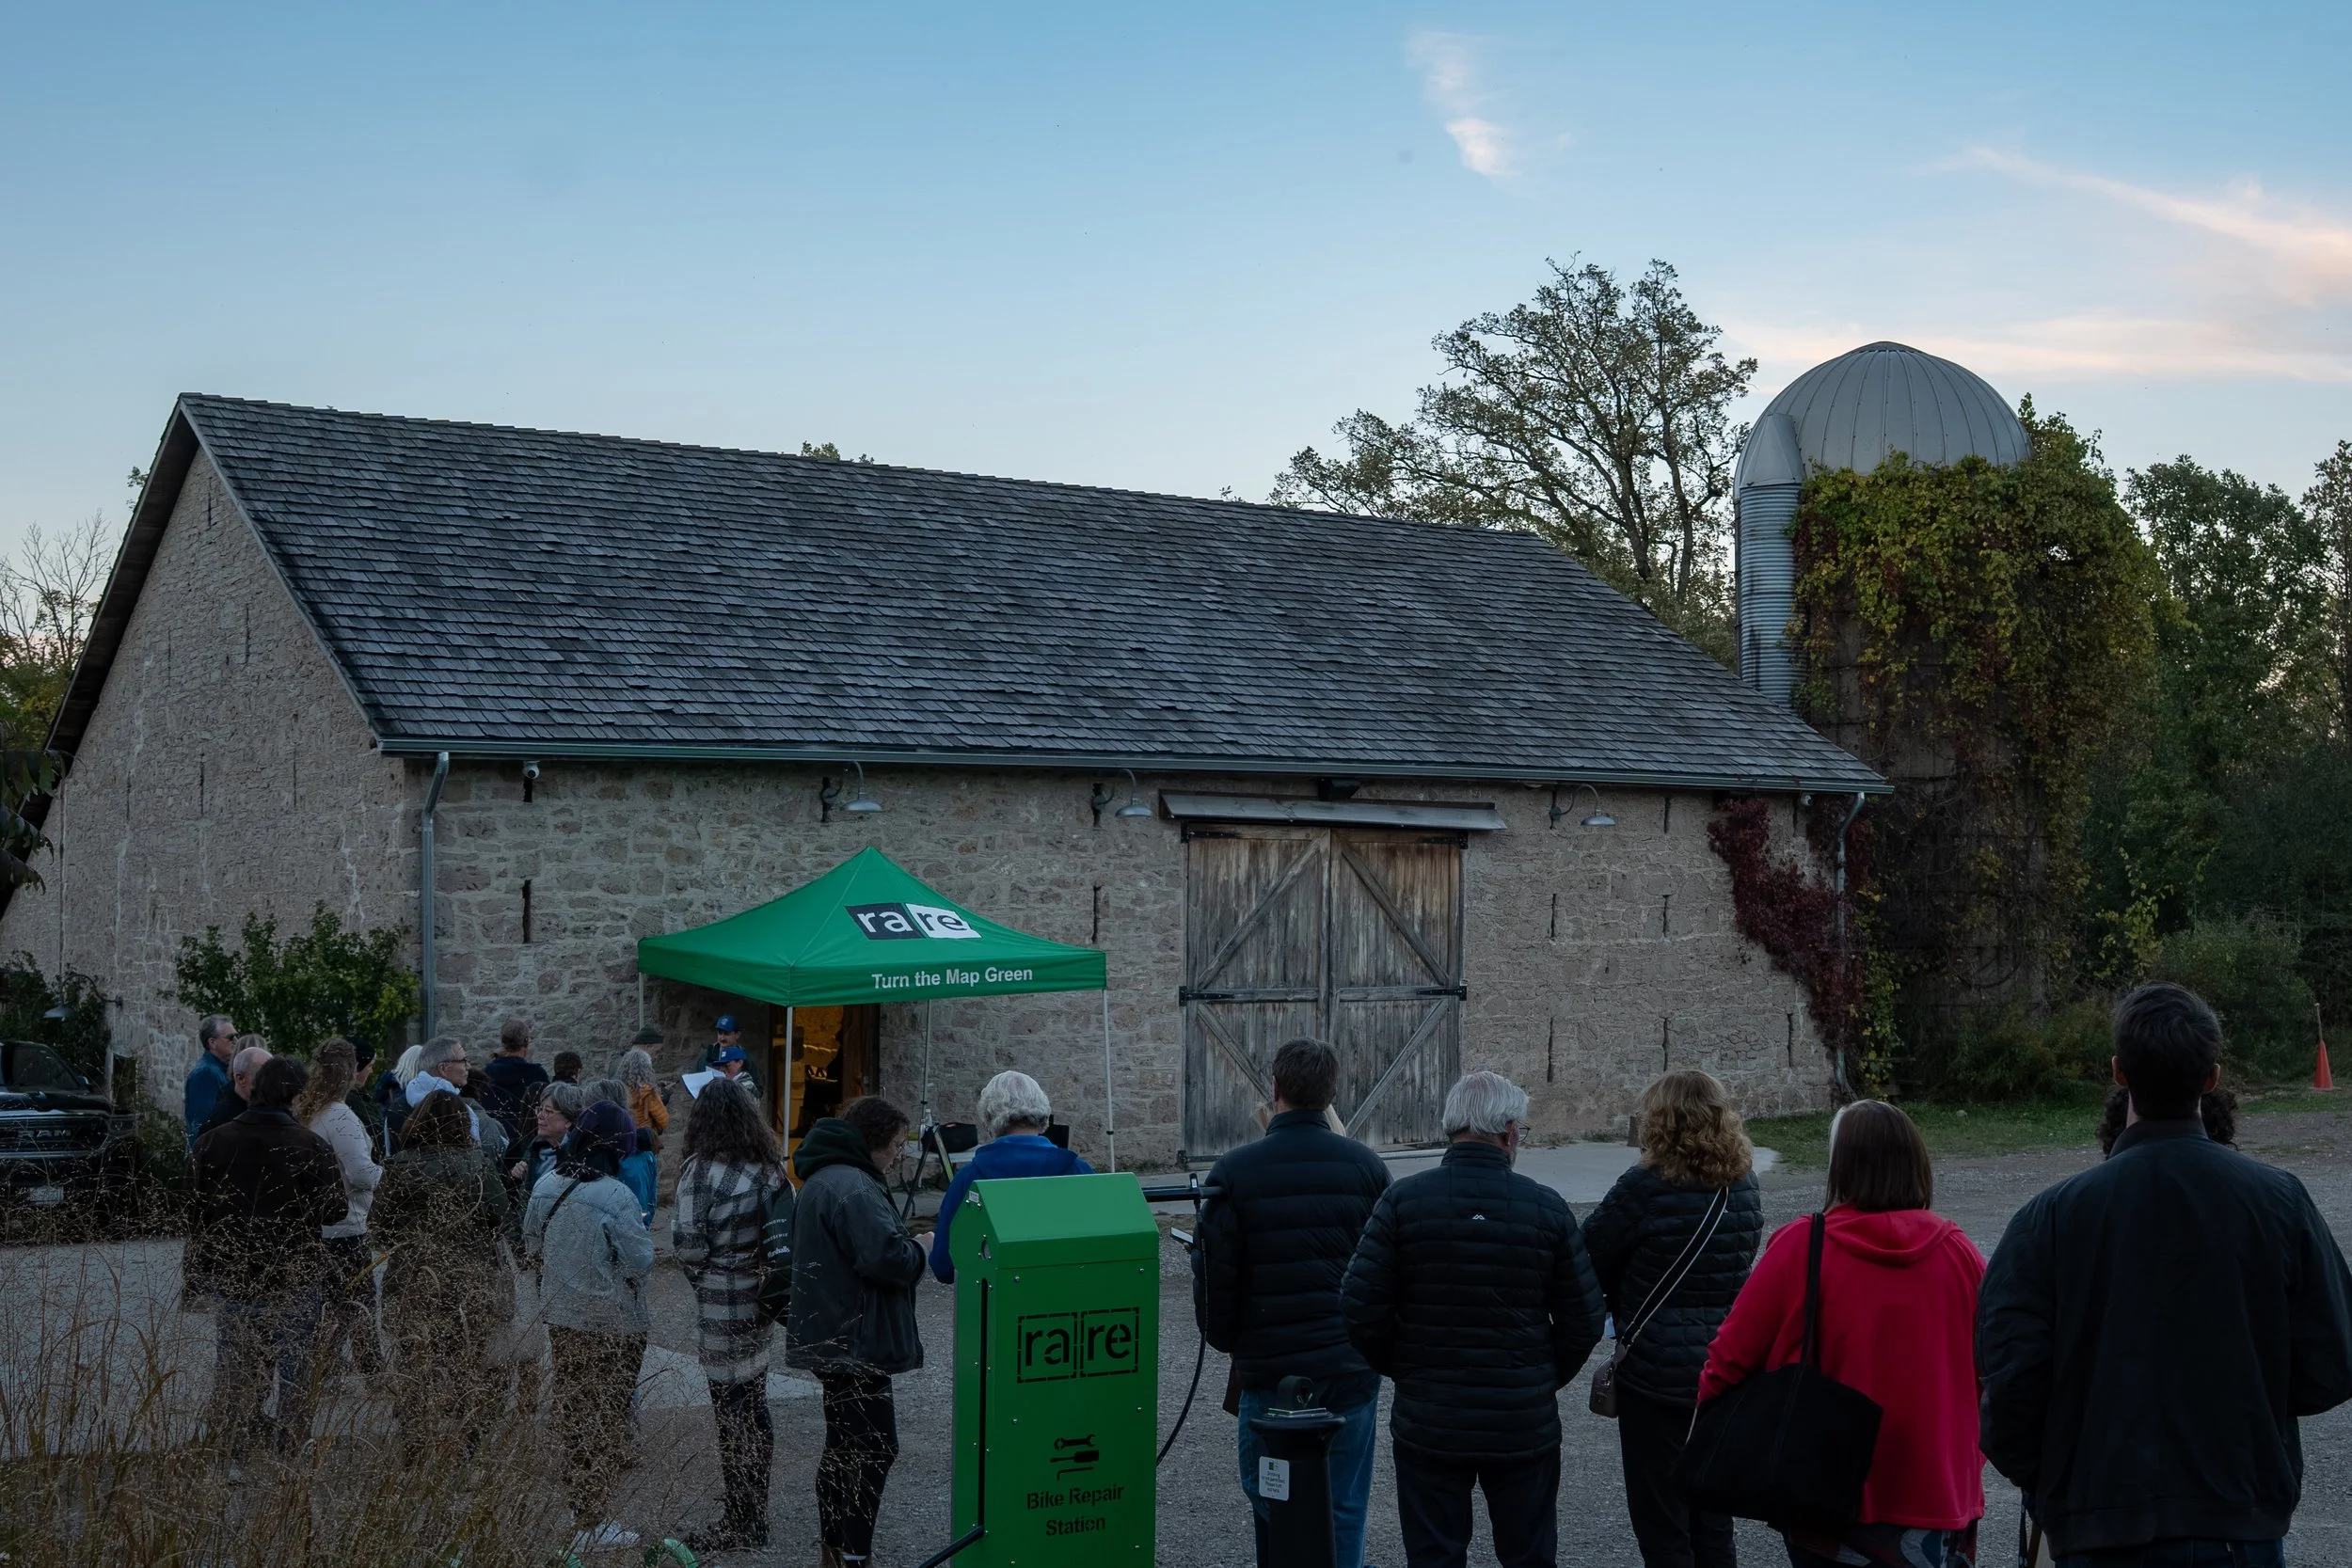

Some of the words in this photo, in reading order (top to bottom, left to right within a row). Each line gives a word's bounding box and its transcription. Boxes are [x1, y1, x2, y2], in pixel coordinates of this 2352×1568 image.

[857, 911, 967, 932] rare
[871, 974, 910, 989] Turn
[914, 971, 941, 987] the
[946, 969, 979, 987] Map
[985, 967, 1033, 982] Green
[1025, 1323, 1132, 1367] rare
[1026, 1491, 1064, 1510] Bike
[1069, 1483, 1124, 1506] Repair
[1045, 1515, 1106, 1536] Station
